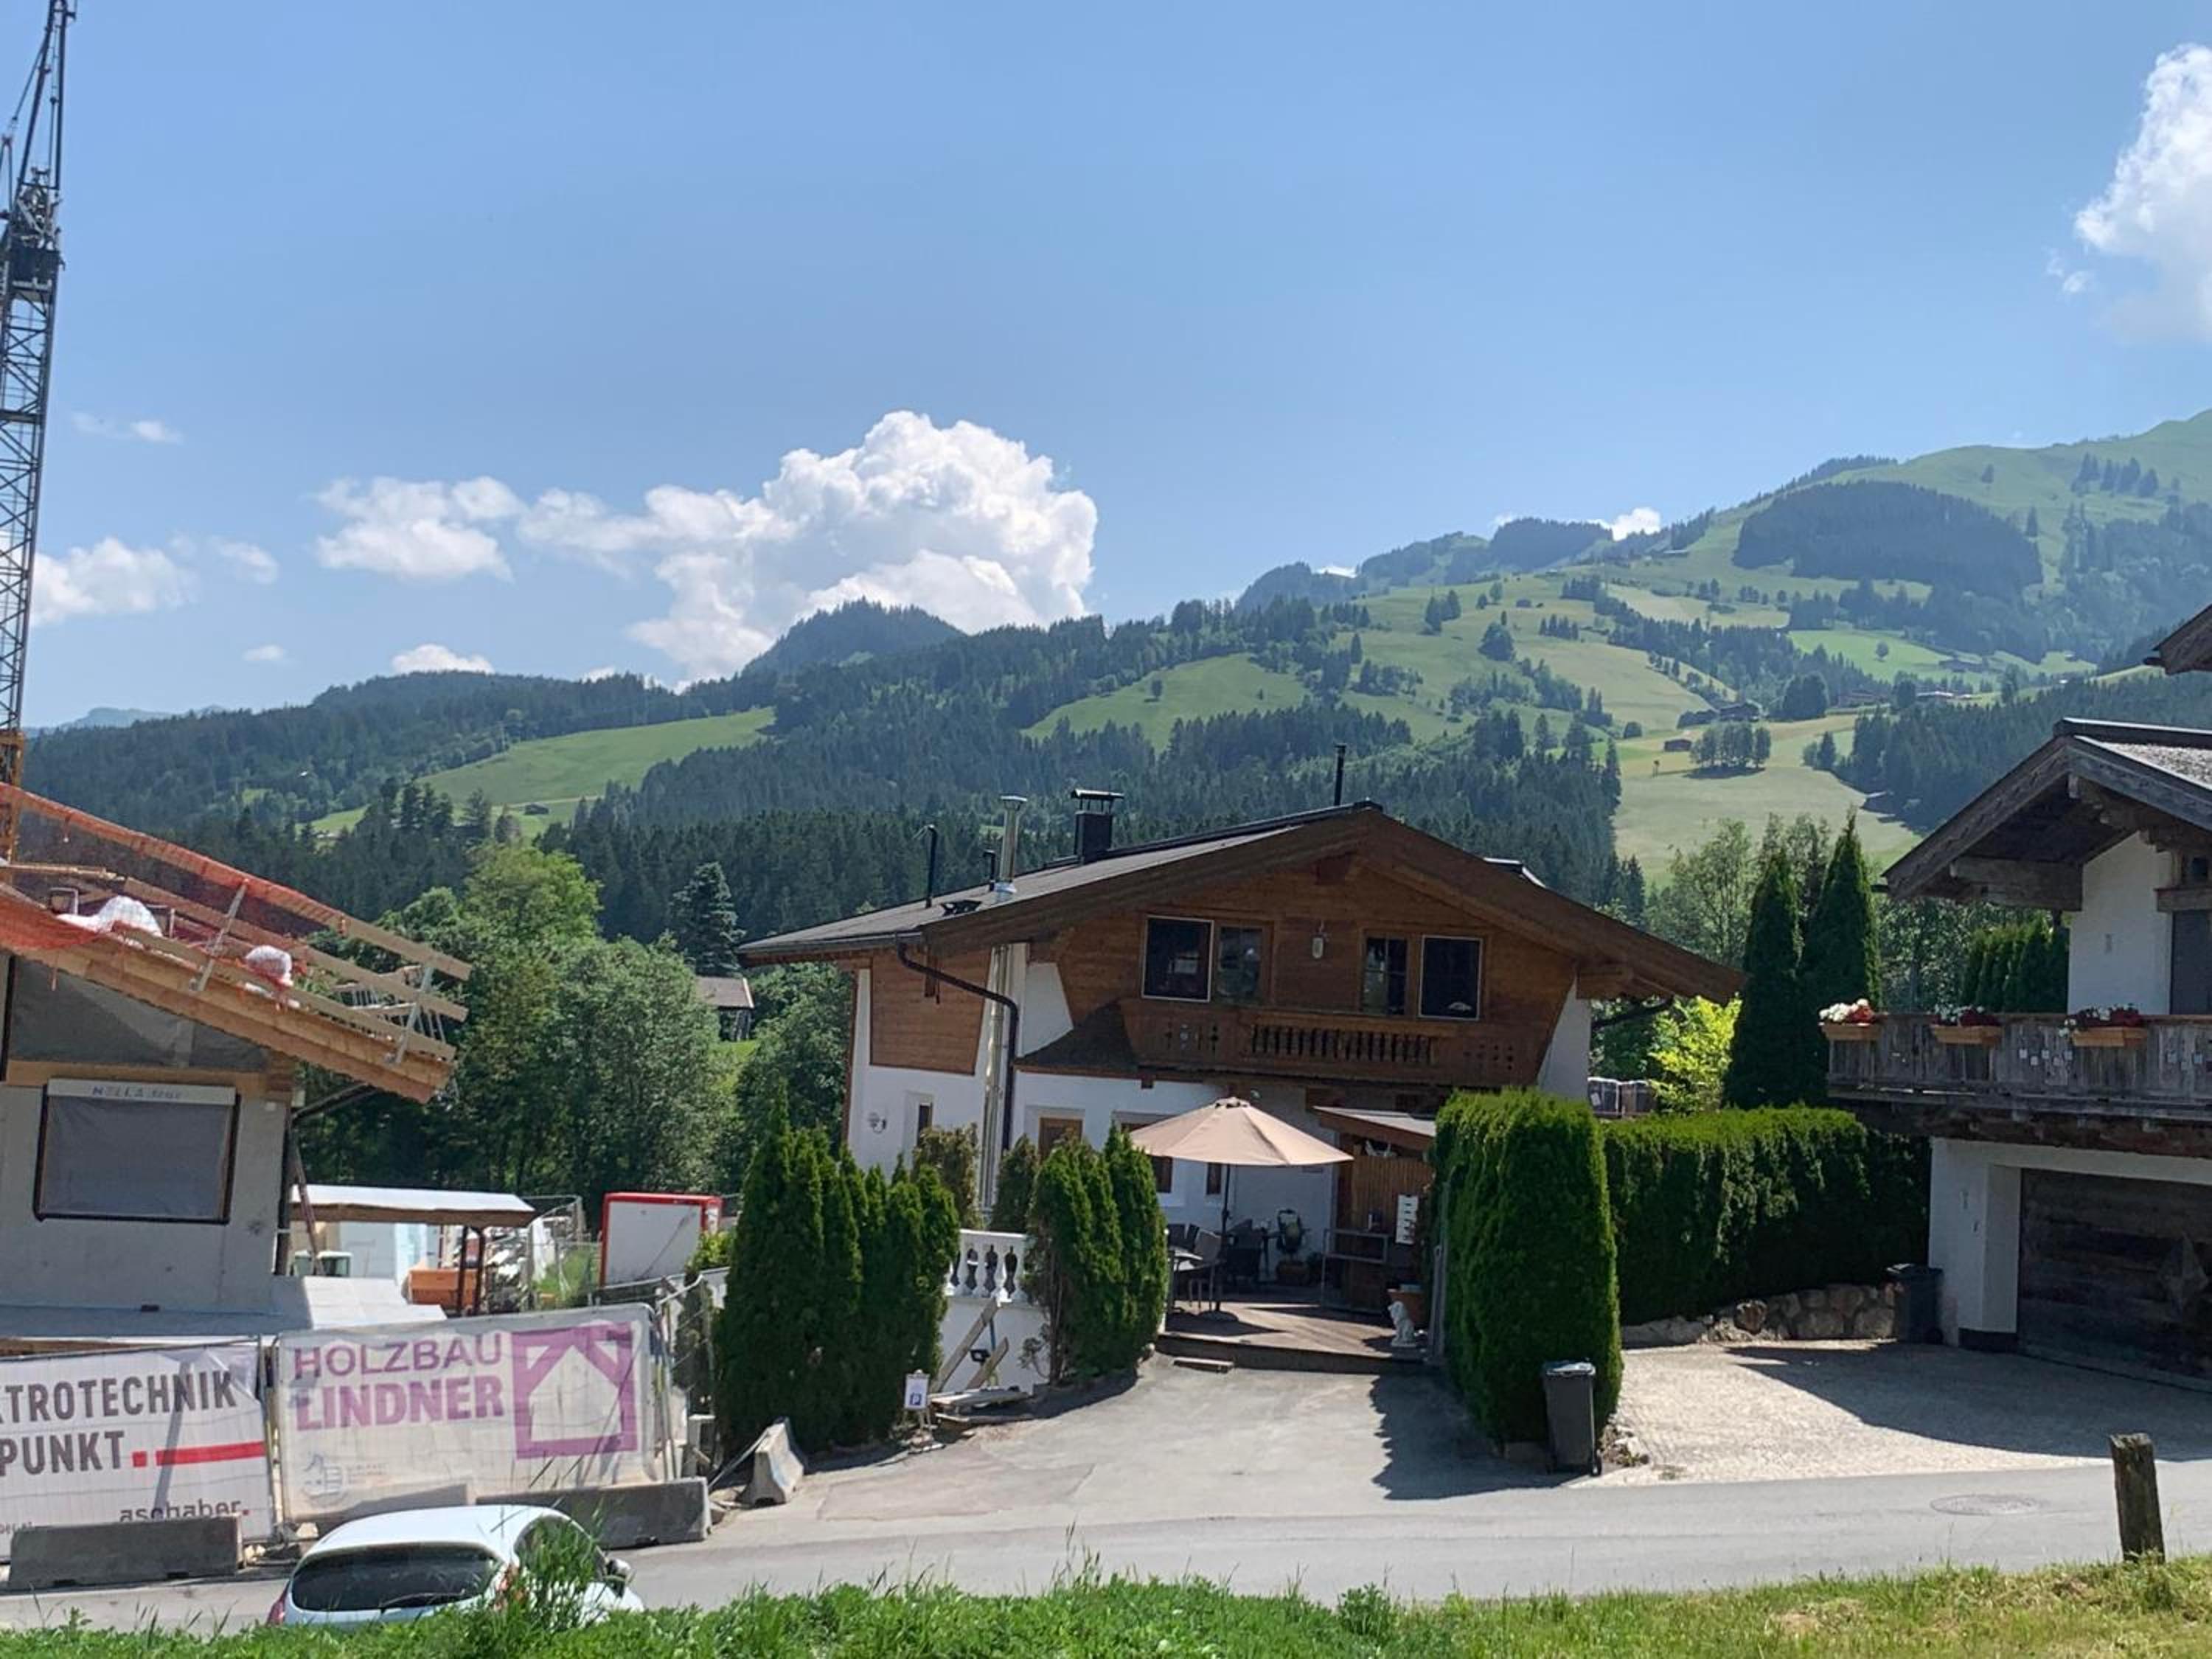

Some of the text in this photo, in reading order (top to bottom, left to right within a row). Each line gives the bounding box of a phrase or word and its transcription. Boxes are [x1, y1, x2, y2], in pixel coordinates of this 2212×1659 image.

[295, 1333, 501, 1379] HOLZBAU
[0, 1371, 237, 1424] TROTECHNIK
[295, 1376, 504, 1430] LINDNER
